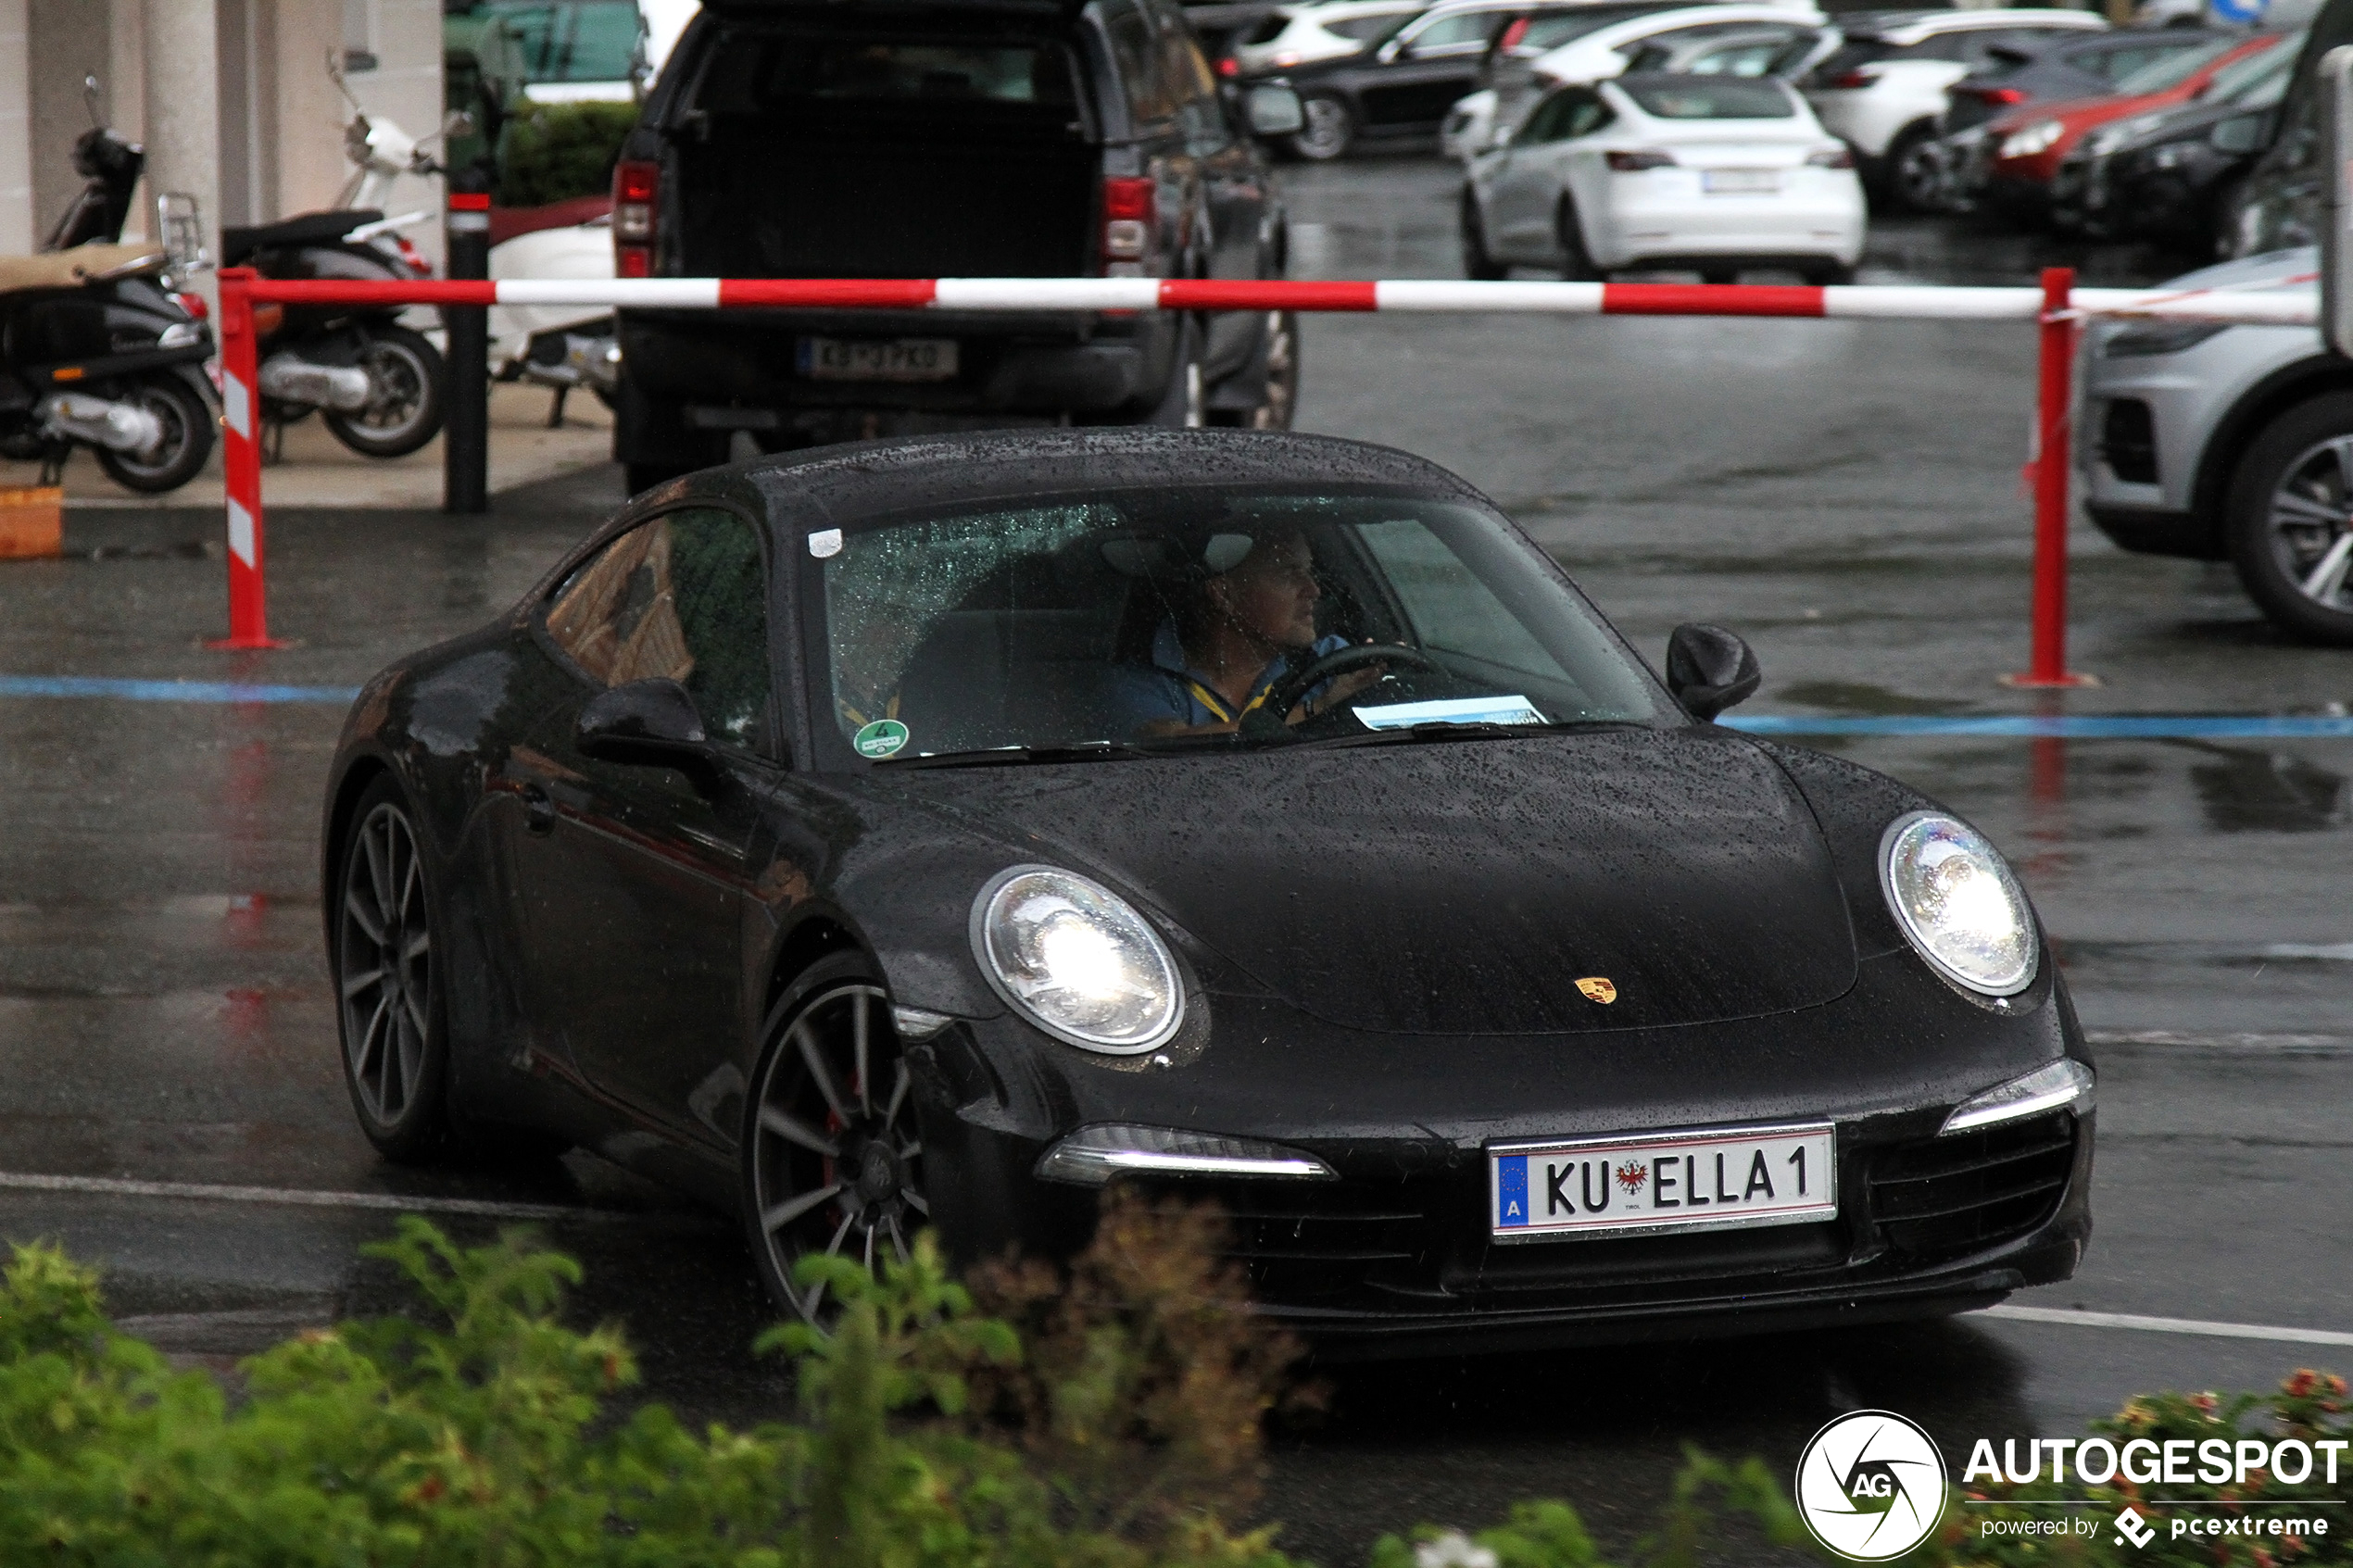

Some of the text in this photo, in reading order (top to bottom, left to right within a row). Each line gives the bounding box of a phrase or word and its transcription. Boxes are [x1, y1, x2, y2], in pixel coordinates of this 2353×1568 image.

[1548, 1146, 1807, 1215] KU ELLA 1
[1506, 1201, 1521, 1216] A
